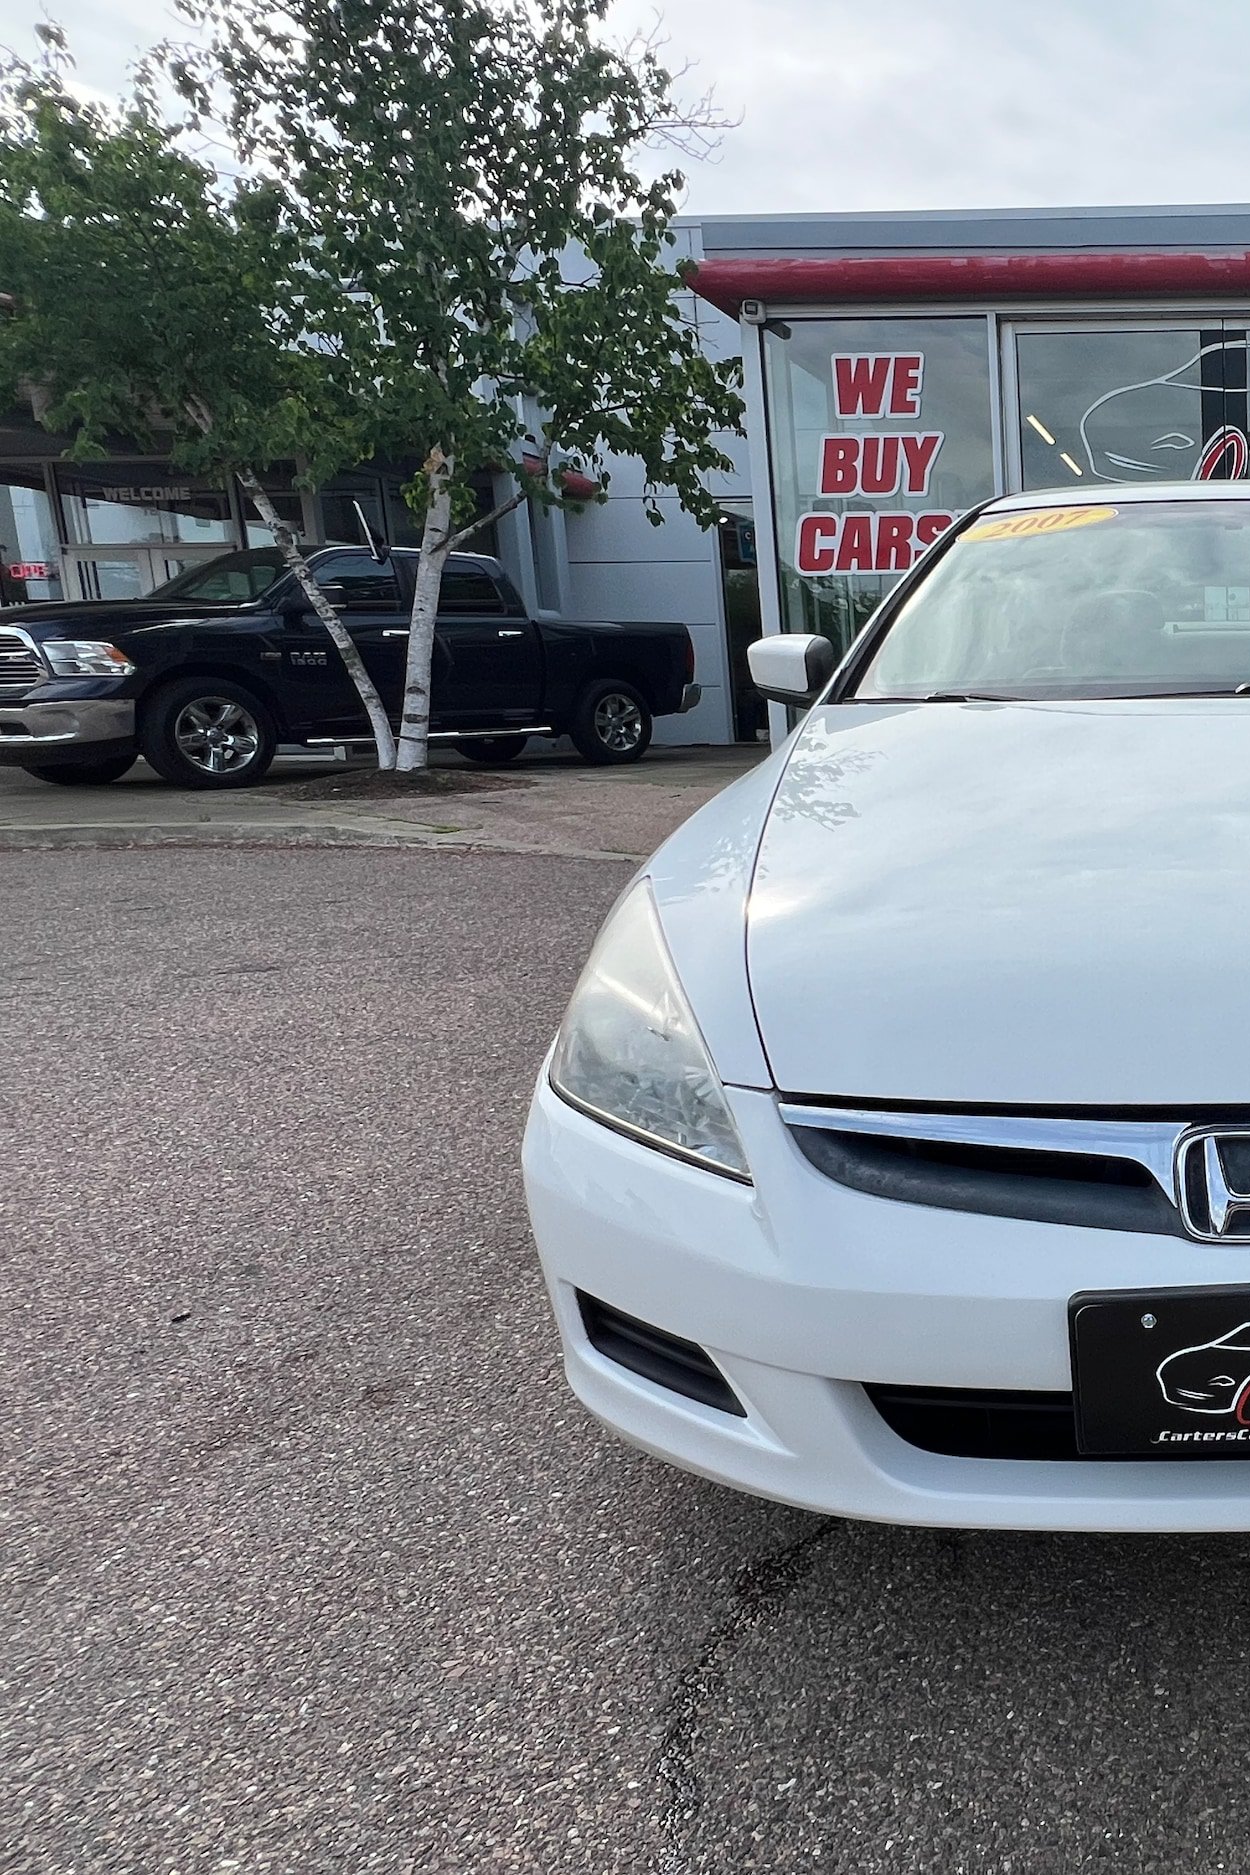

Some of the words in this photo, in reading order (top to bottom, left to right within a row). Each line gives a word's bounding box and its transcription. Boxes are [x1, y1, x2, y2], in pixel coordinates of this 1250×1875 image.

[834, 355, 922, 416] WE
[820, 434, 941, 495] BUY
[102, 486, 192, 501] WELCOME
[984, 509, 1090, 539] 2007
